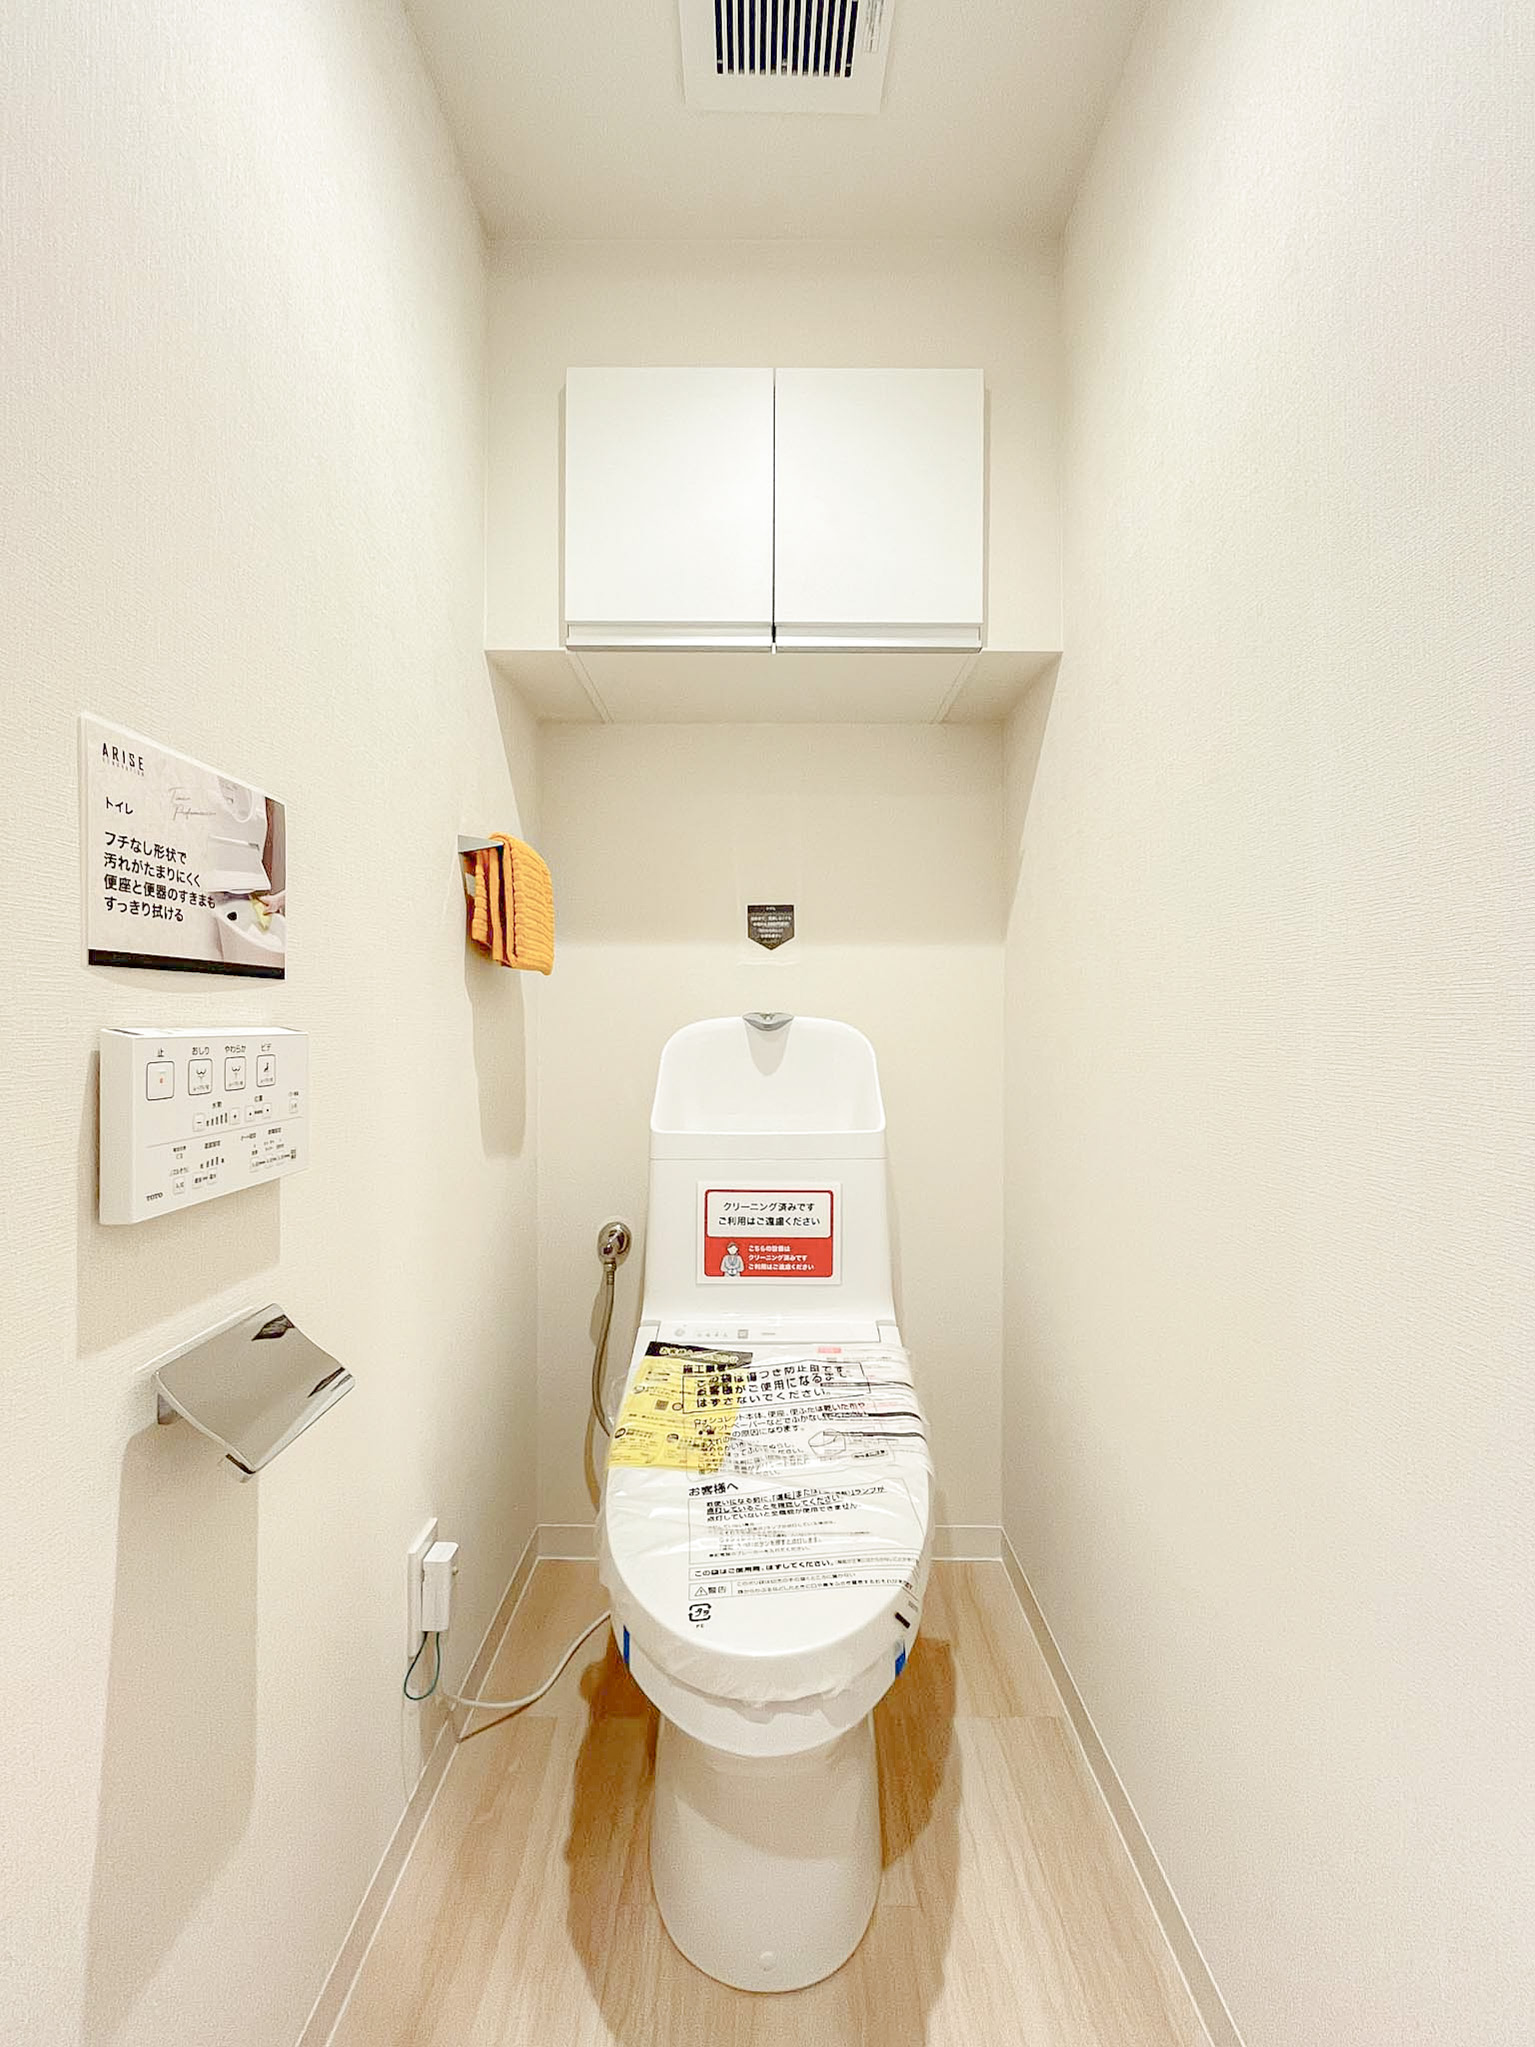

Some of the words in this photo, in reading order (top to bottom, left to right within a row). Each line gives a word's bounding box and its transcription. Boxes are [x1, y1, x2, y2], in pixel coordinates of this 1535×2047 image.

[102, 743, 144, 771] ARISE
[105, 797, 133, 815] トイレ
[104, 831, 187, 865] フチなし形状で
[104, 852, 201, 888] 汚れがたまりにくく
[104, 874, 216, 909] 便座と便器のすきまも
[104, 896, 184, 922] すっきり拭ける
[192, 1047, 209, 1055] おしり
[225, 1045, 246, 1053] やわらか
[261, 1043, 271, 1051] ビデ
[146, 1192, 163, 1201] TOTO
[723, 1202, 815, 1212] クリーニング済みです
[718, 1216, 820, 1226] ご利用はご遠慮ください
[688, 1482, 739, 1497] お客様へ
